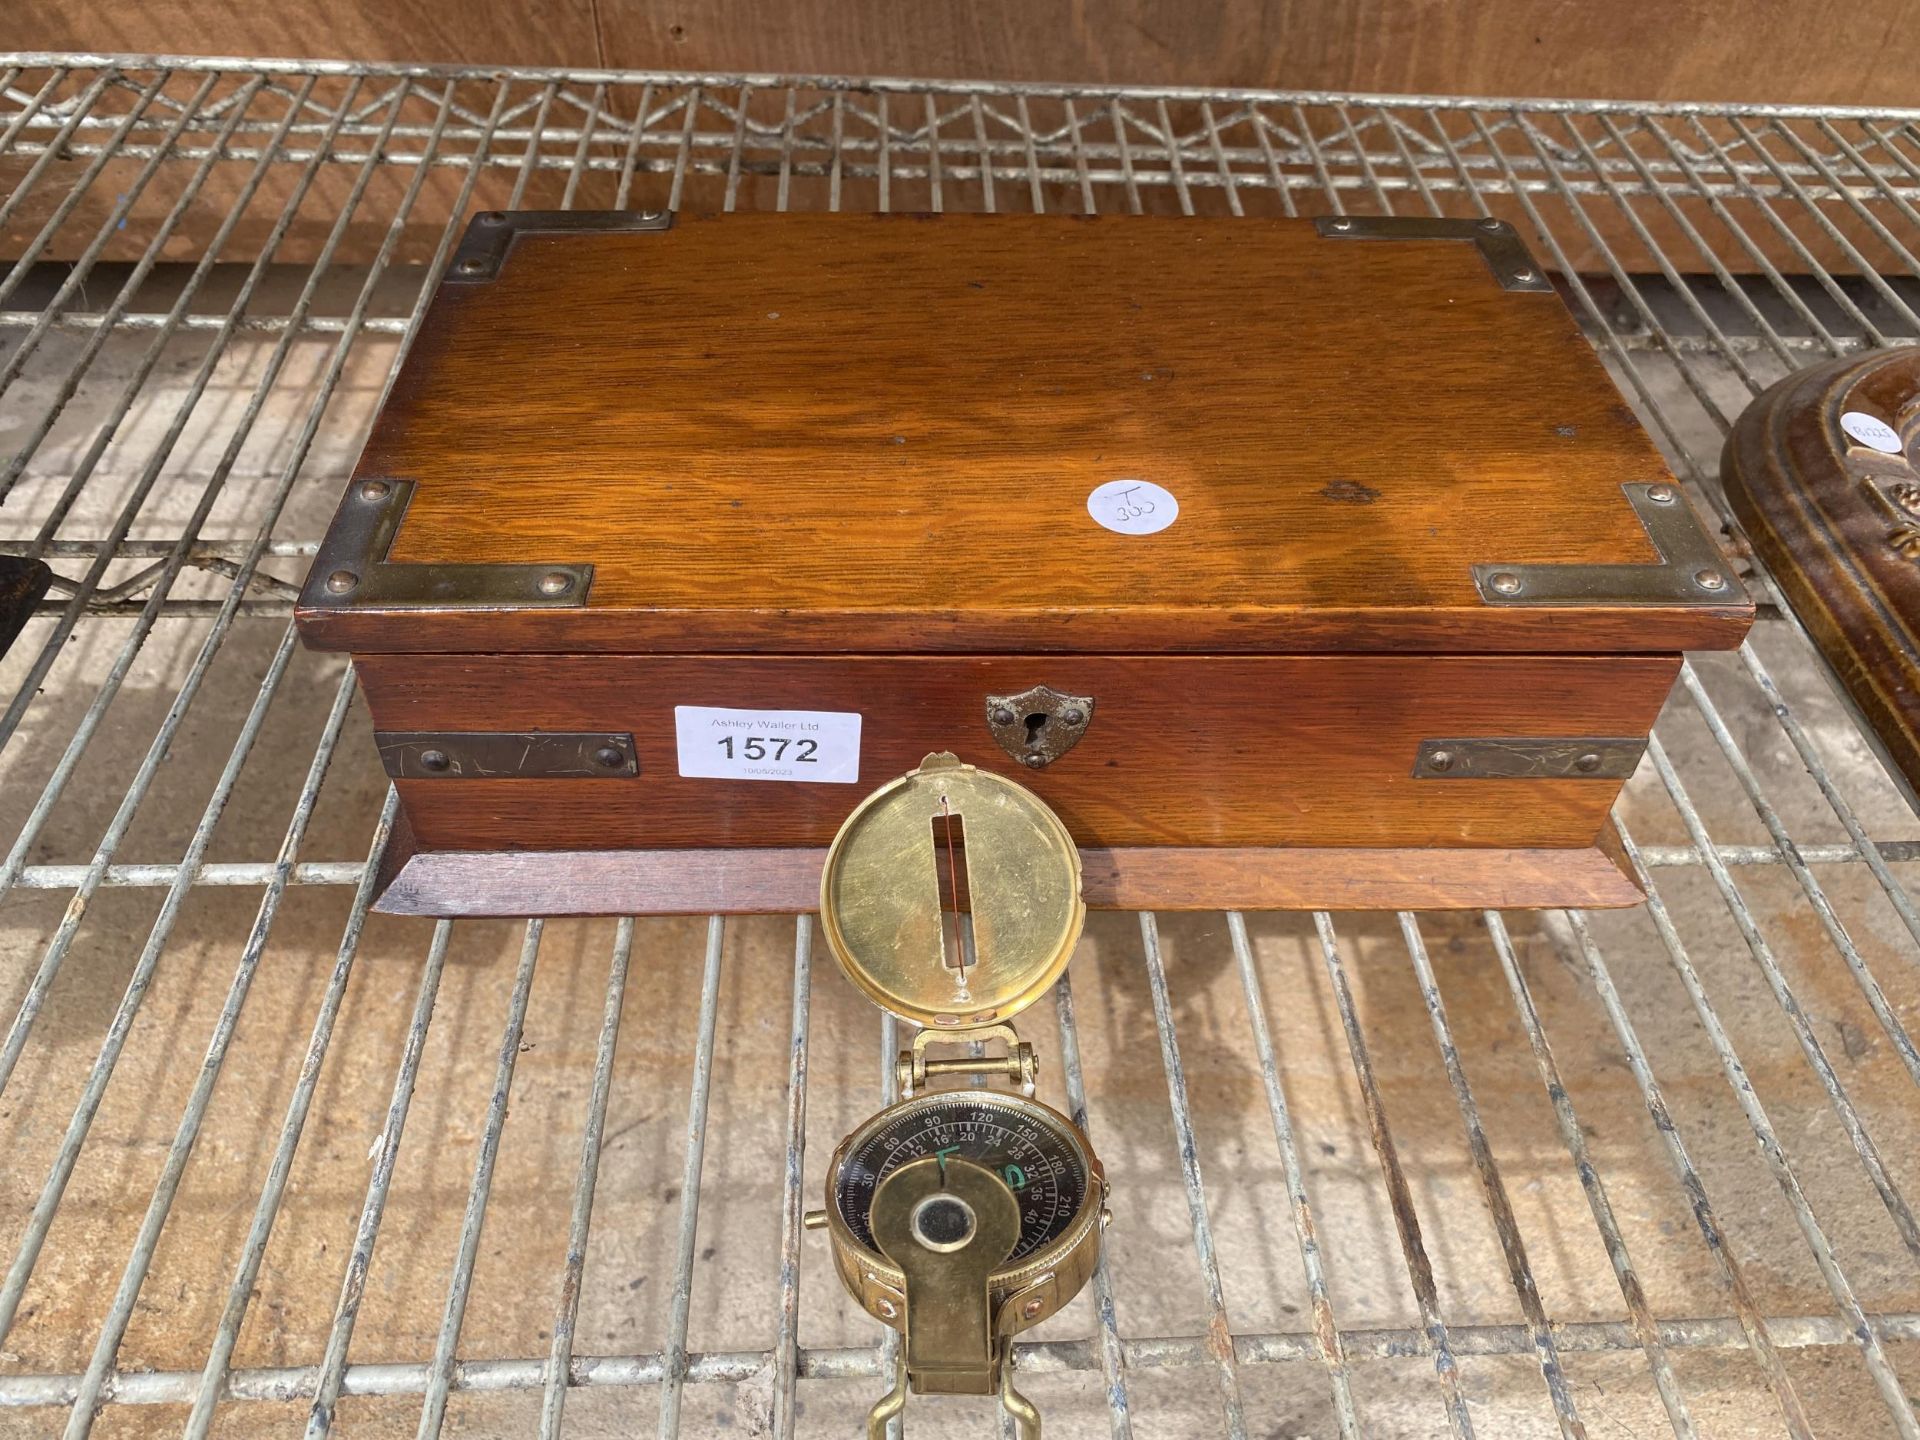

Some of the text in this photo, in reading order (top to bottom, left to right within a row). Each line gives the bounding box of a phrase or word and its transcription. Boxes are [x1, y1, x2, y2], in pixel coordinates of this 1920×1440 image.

[711, 719, 819, 731] Ashley Waller Ltd
[717, 735, 818, 763] 1572
[924, 1115, 941, 1127] 90
[970, 1111, 994, 1123] 120
[959, 1132, 976, 1142] 20
[1017, 1124, 1039, 1142] 150
[883, 1137, 900, 1151] 60
[932, 1136, 949, 1146] 16
[984, 1135, 1002, 1147] 24
[910, 1144, 927, 1158] 12
[1007, 1146, 1025, 1160] 28
[1049, 1154, 1066, 1175] 180
[1024, 1165, 1039, 1179] 32
[861, 1173, 875, 1188] 30
[1031, 1187, 1043, 1201] 36
[1058, 1195, 1072, 1217] 210
[1024, 1208, 1039, 1224] 40
